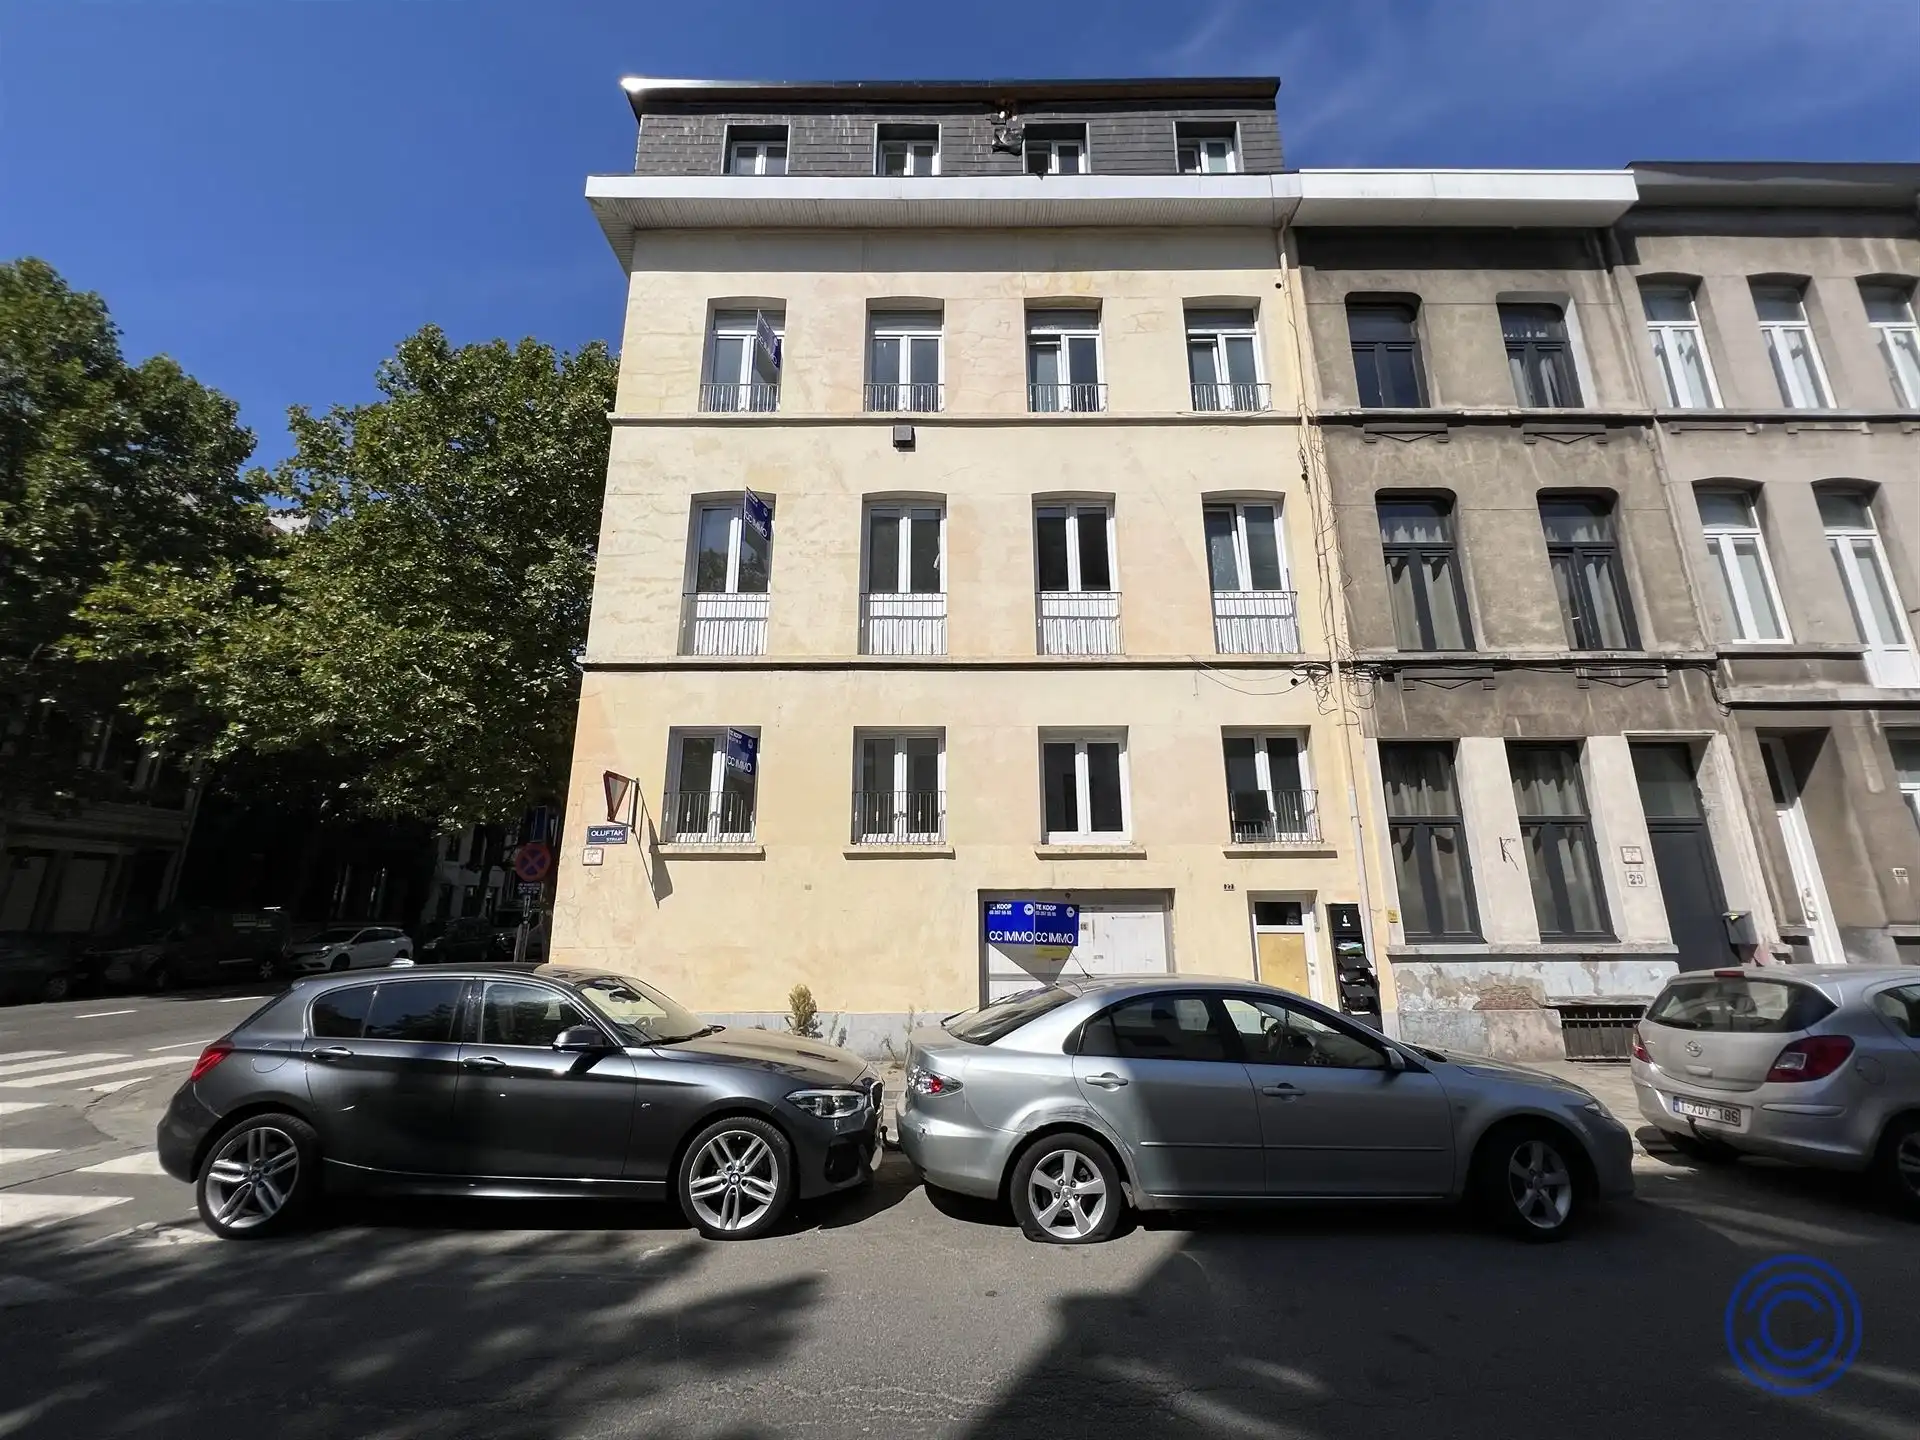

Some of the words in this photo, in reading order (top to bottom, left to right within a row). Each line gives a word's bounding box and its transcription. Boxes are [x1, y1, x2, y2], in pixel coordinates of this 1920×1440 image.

[1042, 904, 1057, 912] KOOP
[989, 930, 1003, 941] CC
[1004, 931, 1034, 943] IMMO
[1035, 932, 1048, 943] CC
[1048, 932, 1074, 944] IMMO
